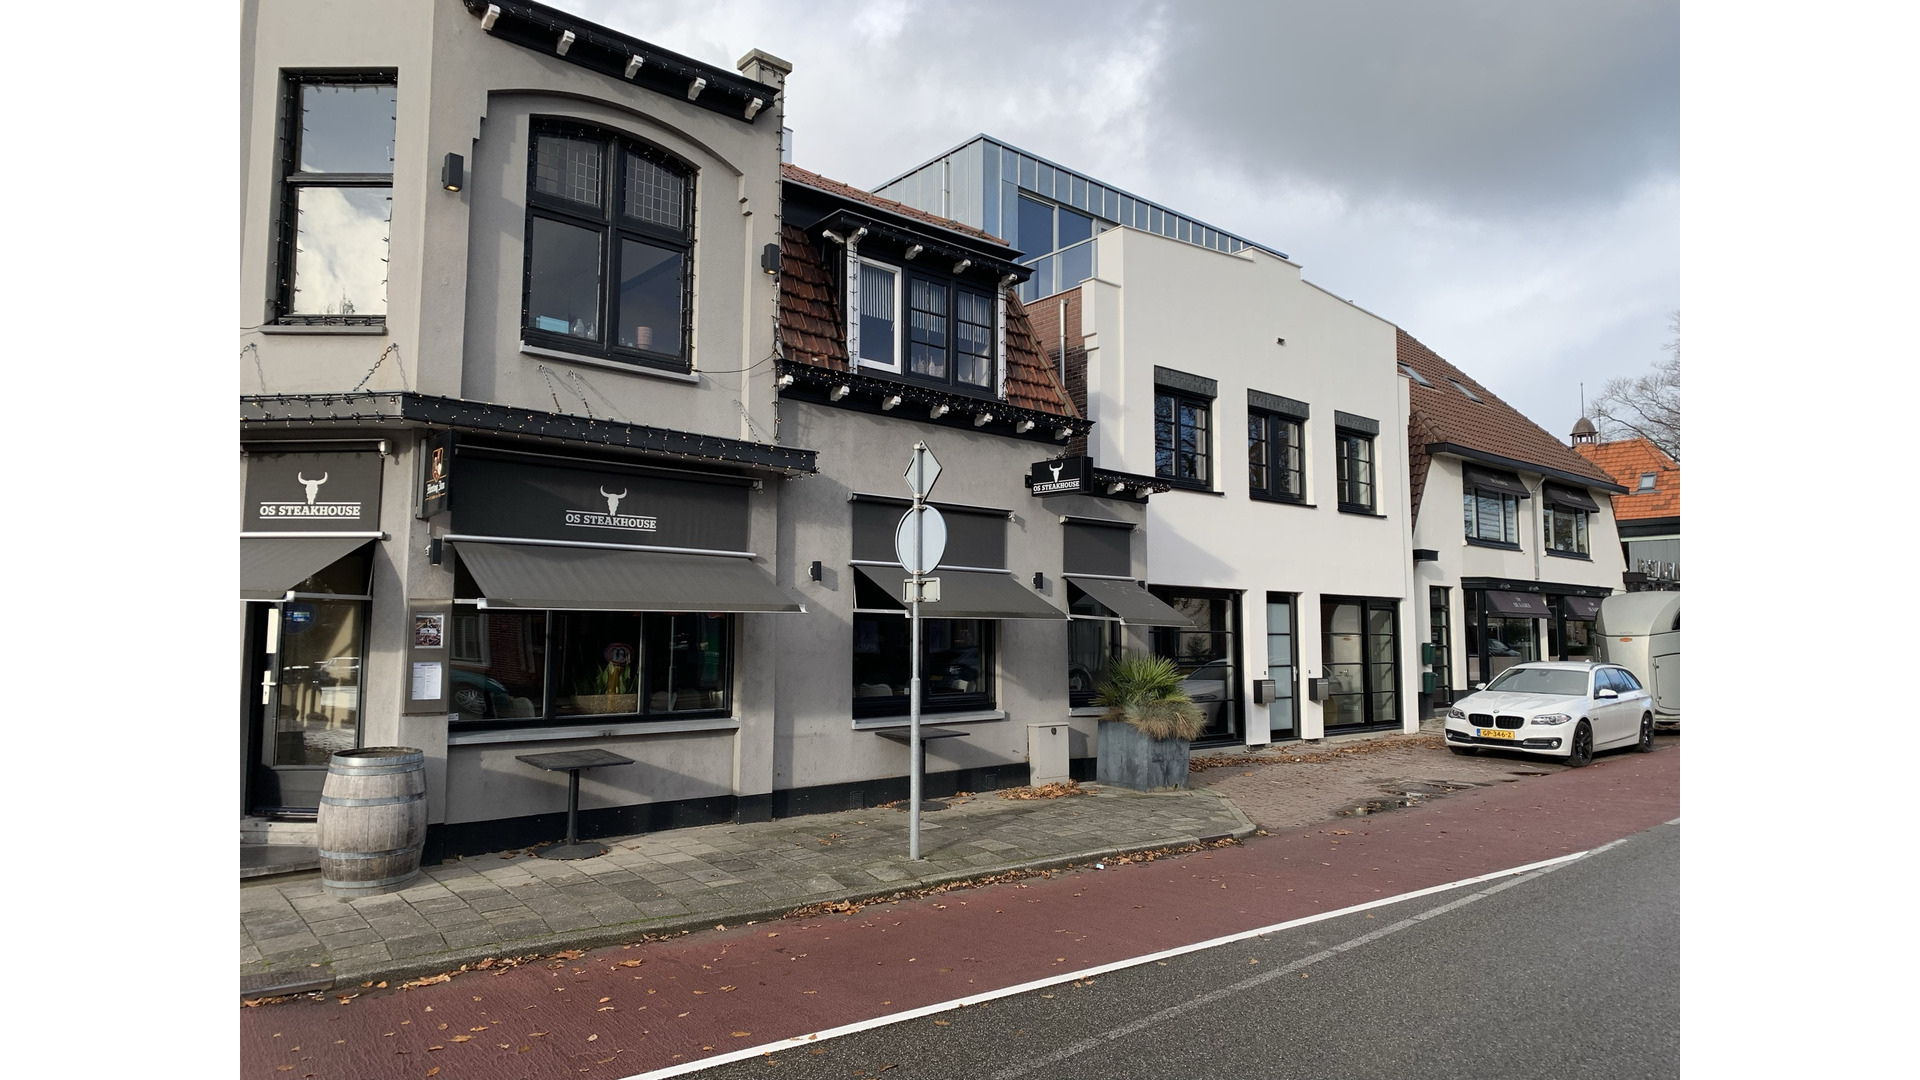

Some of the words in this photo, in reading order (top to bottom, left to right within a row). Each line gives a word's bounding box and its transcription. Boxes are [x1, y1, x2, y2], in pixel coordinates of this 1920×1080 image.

[1041, 480, 1080, 491] STEAKHOUSE
[260, 505, 276, 516] OS
[278, 505, 361, 516] STEAKHOUSE
[565, 513, 581, 523] OS
[583, 514, 657, 529] STEAKHOUSE
[1482, 730, 1512, 738] GP-346-Z
